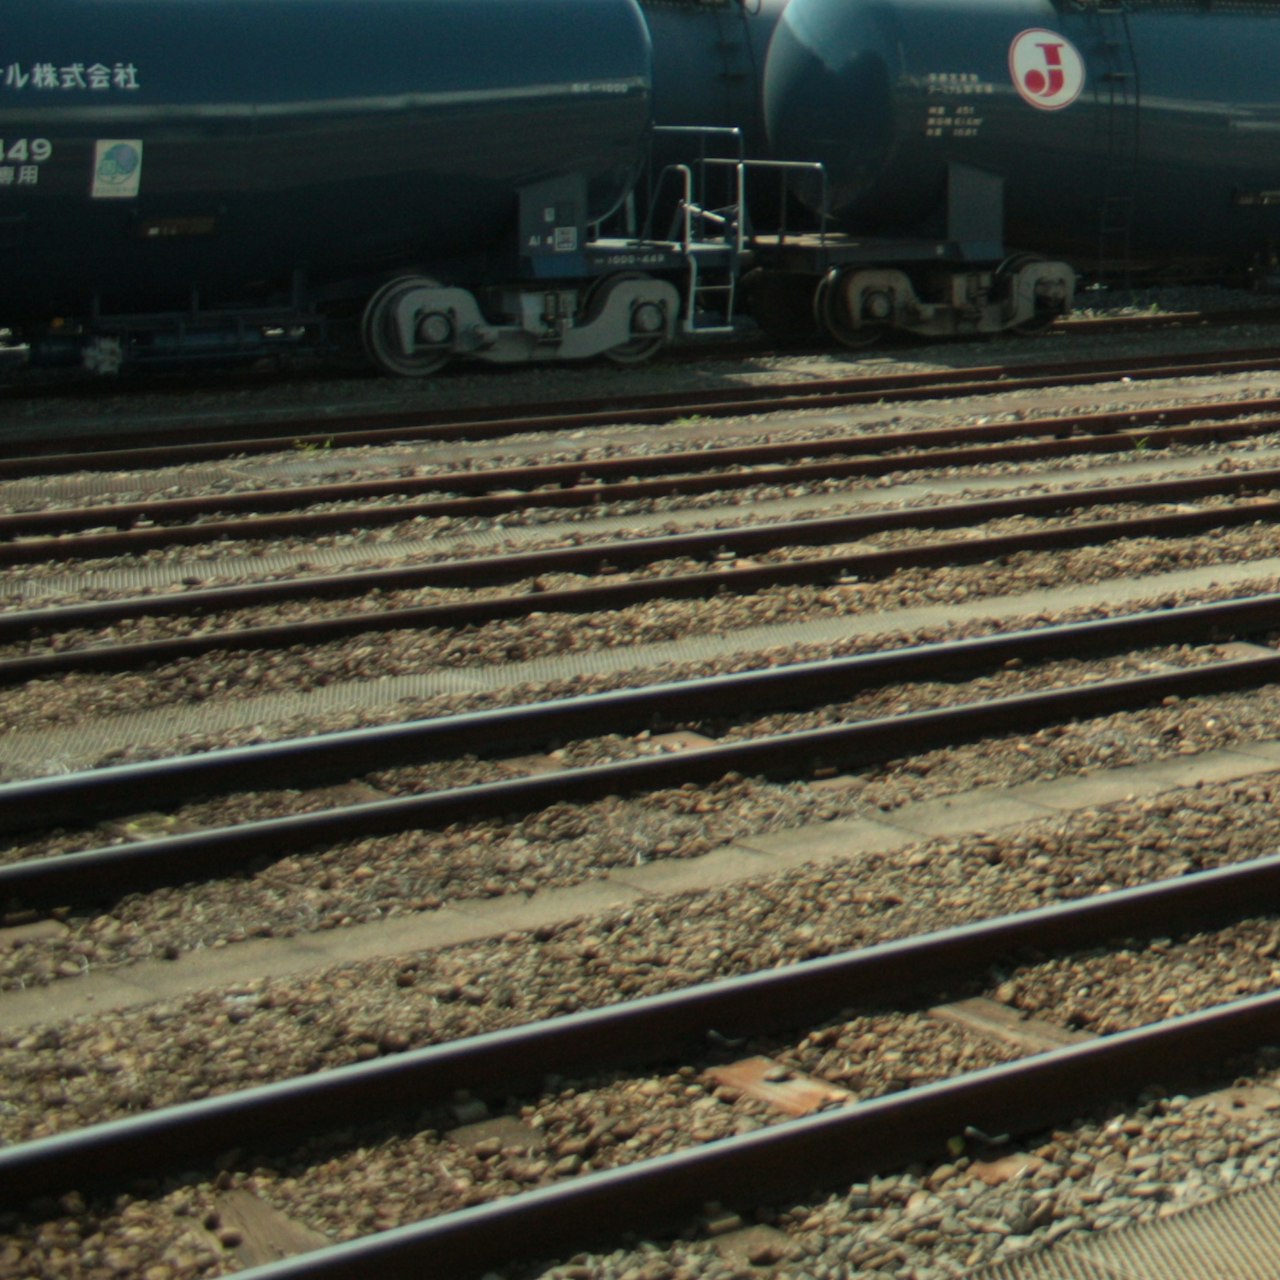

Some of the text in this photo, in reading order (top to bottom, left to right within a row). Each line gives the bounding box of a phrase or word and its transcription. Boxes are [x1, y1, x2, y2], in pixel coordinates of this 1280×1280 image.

[0, 62, 140, 89] ル株式会社
[0, 138, 52, 161] 49
